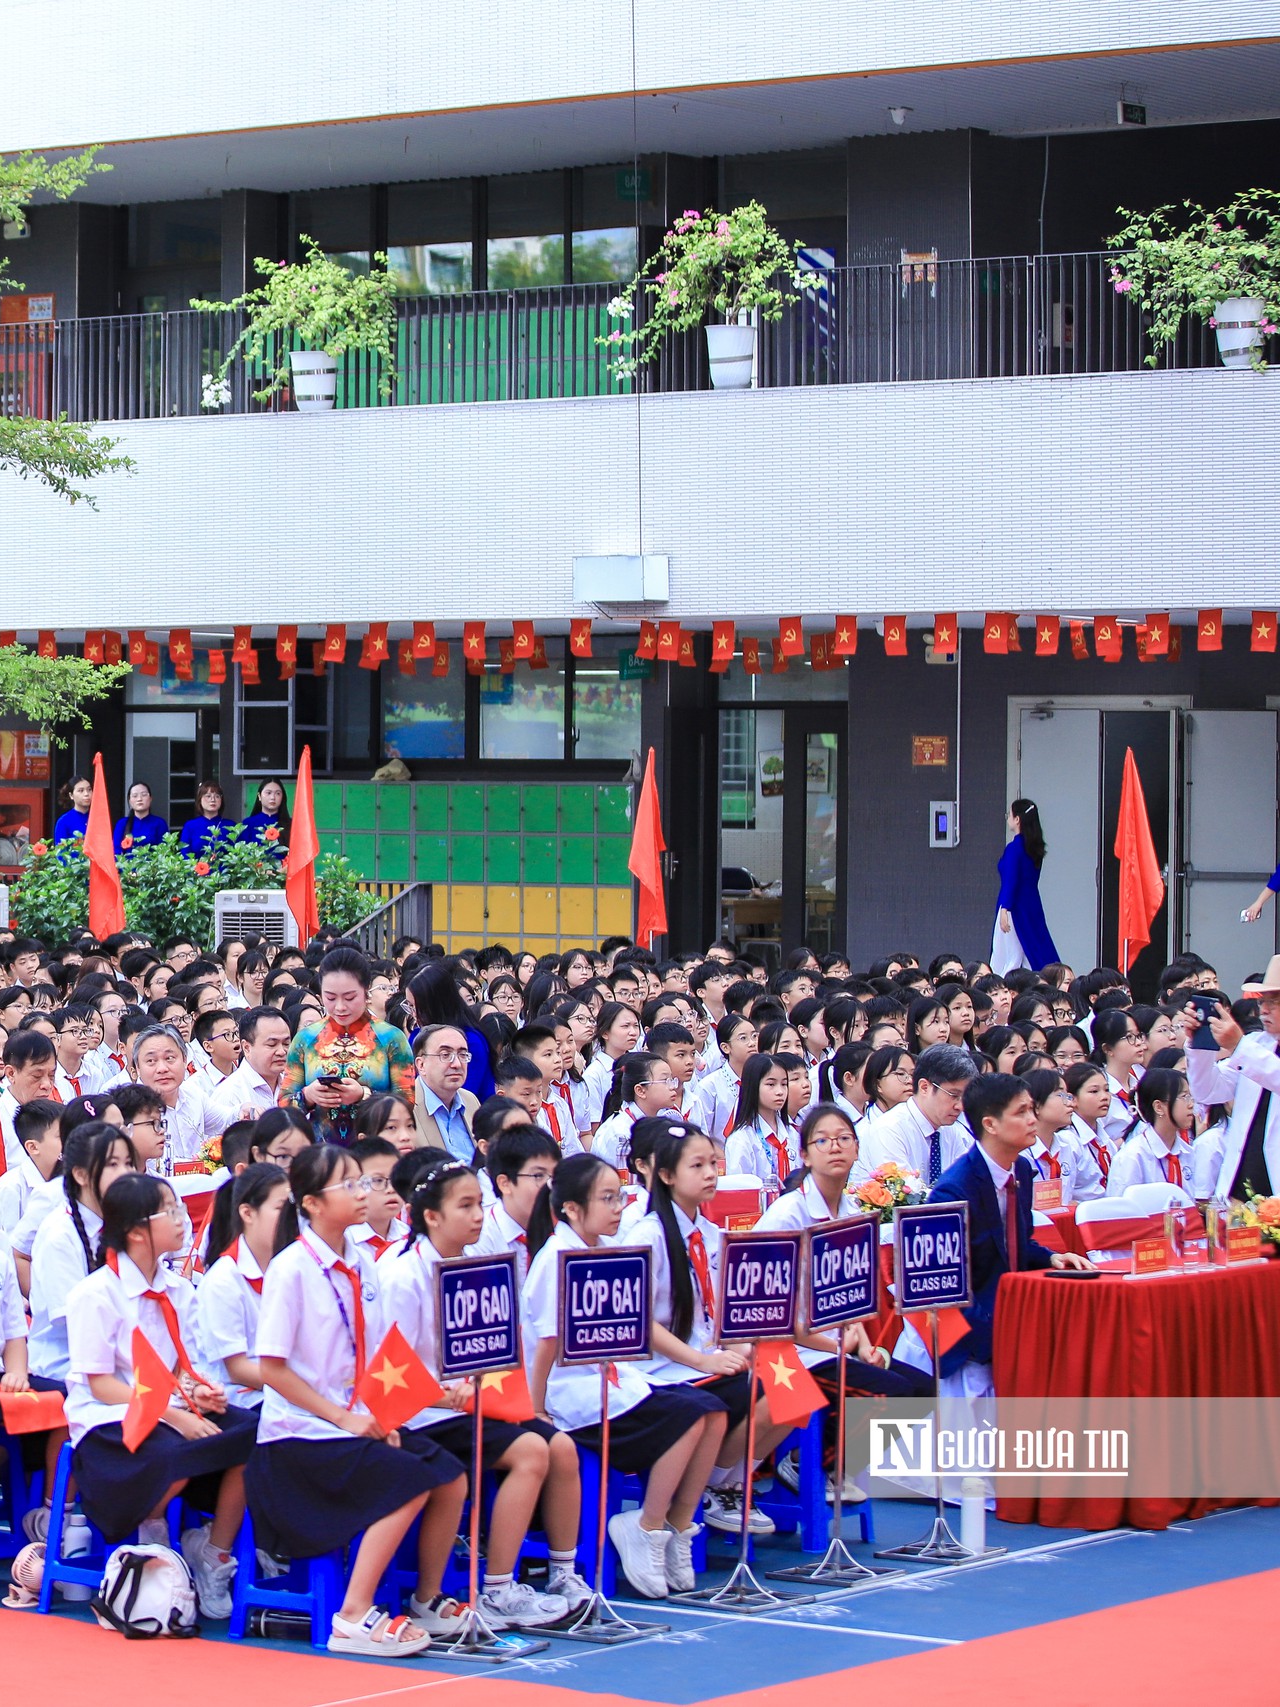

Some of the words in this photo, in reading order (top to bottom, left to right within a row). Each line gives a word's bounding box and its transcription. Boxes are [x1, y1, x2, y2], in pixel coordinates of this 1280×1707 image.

[904, 1225, 934, 1268] LỚP
[936, 1231, 961, 1265] 6A2
[726, 1252, 762, 1297] LỚP
[763, 1260, 791, 1295] 6A3
[813, 1242, 842, 1287] LỚP
[843, 1241, 870, 1279] 6A4
[571, 1270, 609, 1317] LỚP
[611, 1277, 641, 1315] 6A1
[817, 1291, 847, 1312] CLASS
[848, 1286, 866, 1303] 6A4
[910, 1276, 940, 1293] CLASS
[941, 1274, 958, 1289] 6A2
[444, 1280, 478, 1330] LỚP
[480, 1284, 510, 1324] 6A0
[730, 1307, 765, 1323] CLASS
[766, 1306, 785, 1321] 6A3
[451, 1336, 486, 1356] CLASS
[487, 1333, 508, 1351] 6A0
[576, 1326, 615, 1344] CLASS
[616, 1325, 636, 1341] 6A1
